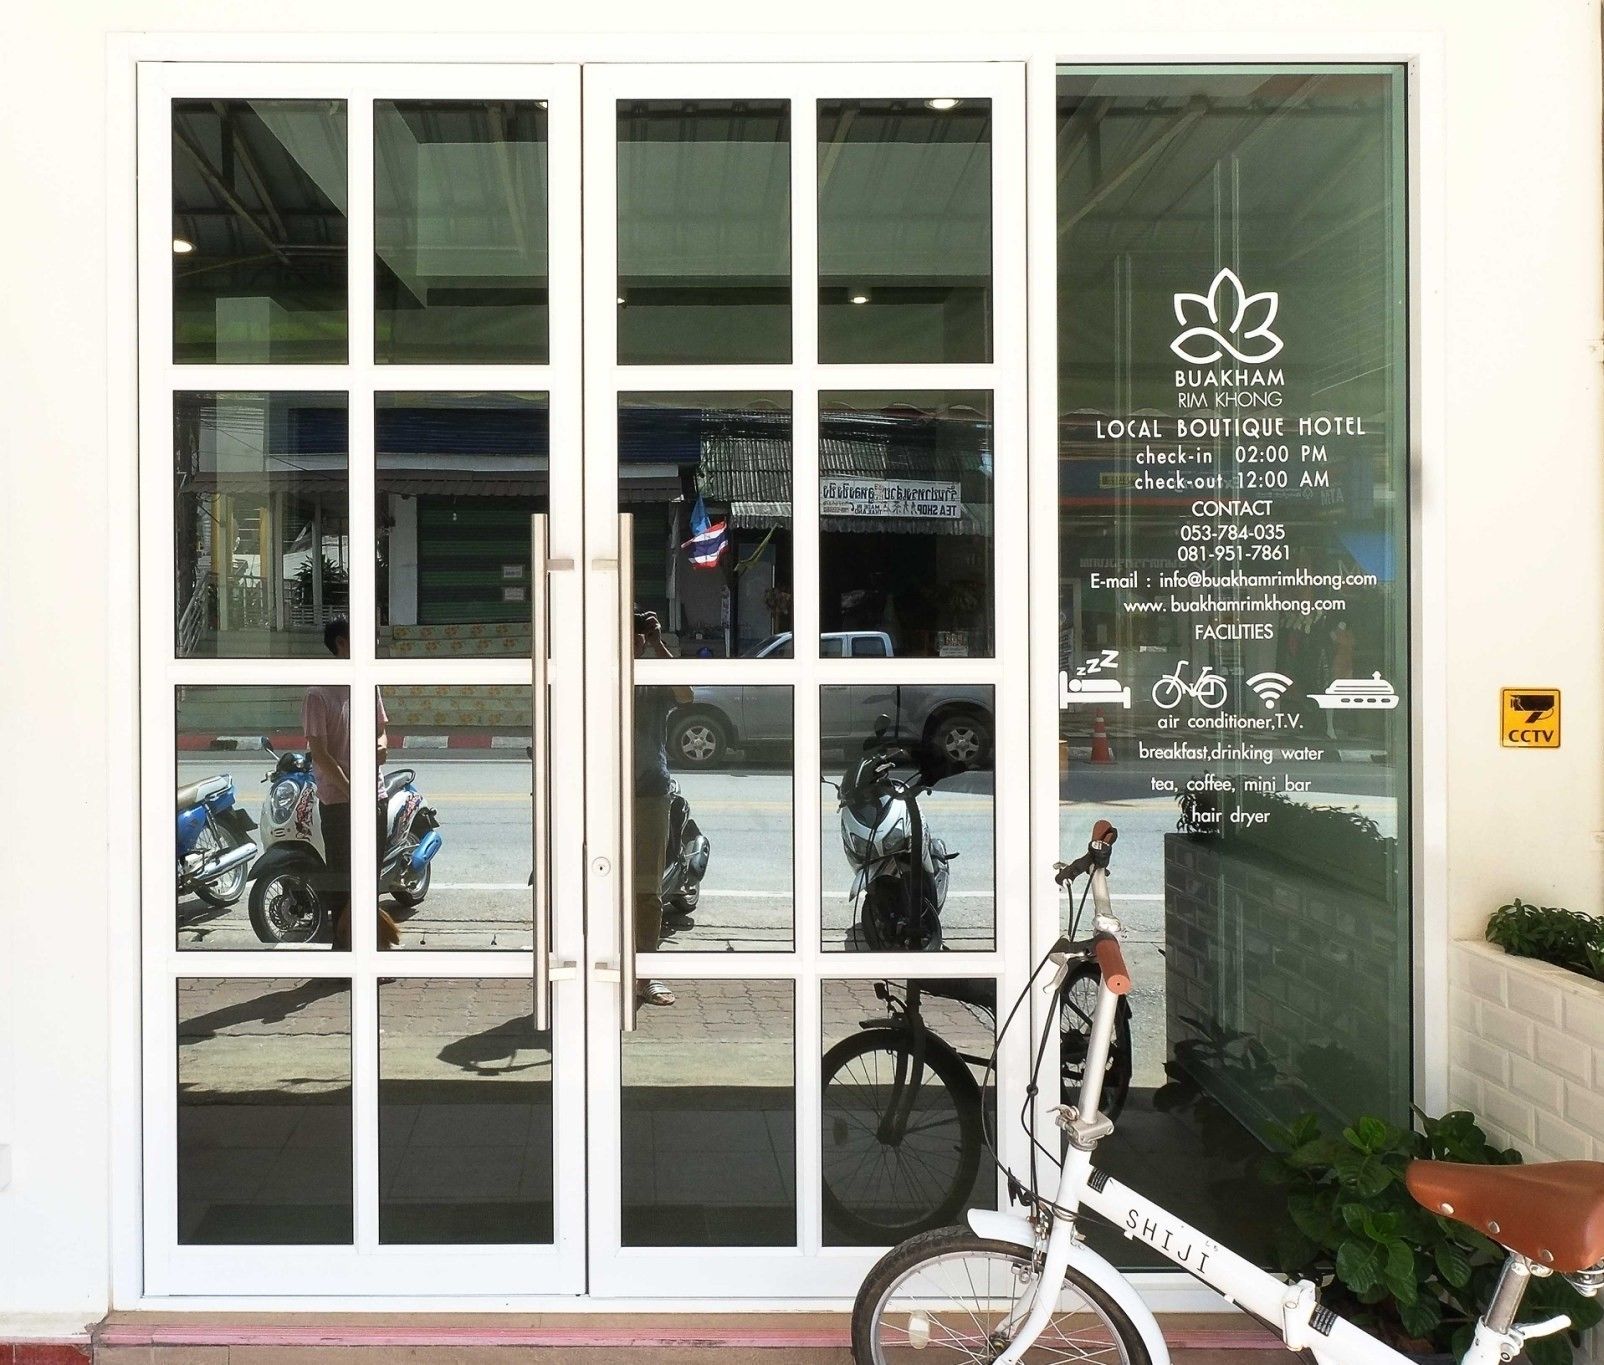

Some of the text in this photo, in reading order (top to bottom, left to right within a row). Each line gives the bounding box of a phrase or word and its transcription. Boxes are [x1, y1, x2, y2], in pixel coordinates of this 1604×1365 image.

[1175, 368, 1285, 388] BUAKHAM
[1178, 391, 1283, 409] RIM KHONG
[1095, 416, 1366, 439] LOCAL BOUTIQUE HOTEL
[1135, 444, 1328, 466] check-in 02:00 PM
[1134, 470, 1223, 490] check-out
[1237, 470, 1289, 489] 12:00
[1299, 470, 1330, 488] AM
[1191, 500, 1274, 517] CONTACT
[1180, 523, 1286, 542] 053-784-035
[1177, 544, 1290, 563] 081-951-7861
[1090, 572, 1138, 589] E-mail
[1159, 568, 1378, 591] info@buakhamrimkhong.com
[1123, 593, 1346, 615] www. buakhamrimkhong.com
[1194, 622, 1274, 640] FACILITIES
[1157, 712, 1304, 733] air conditioner,T.V.
[1508, 729, 1555, 743] CCTV
[1138, 741, 1324, 764] breakfast,drinking water
[1150, 774, 1312, 794] tea, coffee, mini bar
[1191, 804, 1271, 830] hair dryer
[1126, 1209, 1209, 1274] SHIJI
